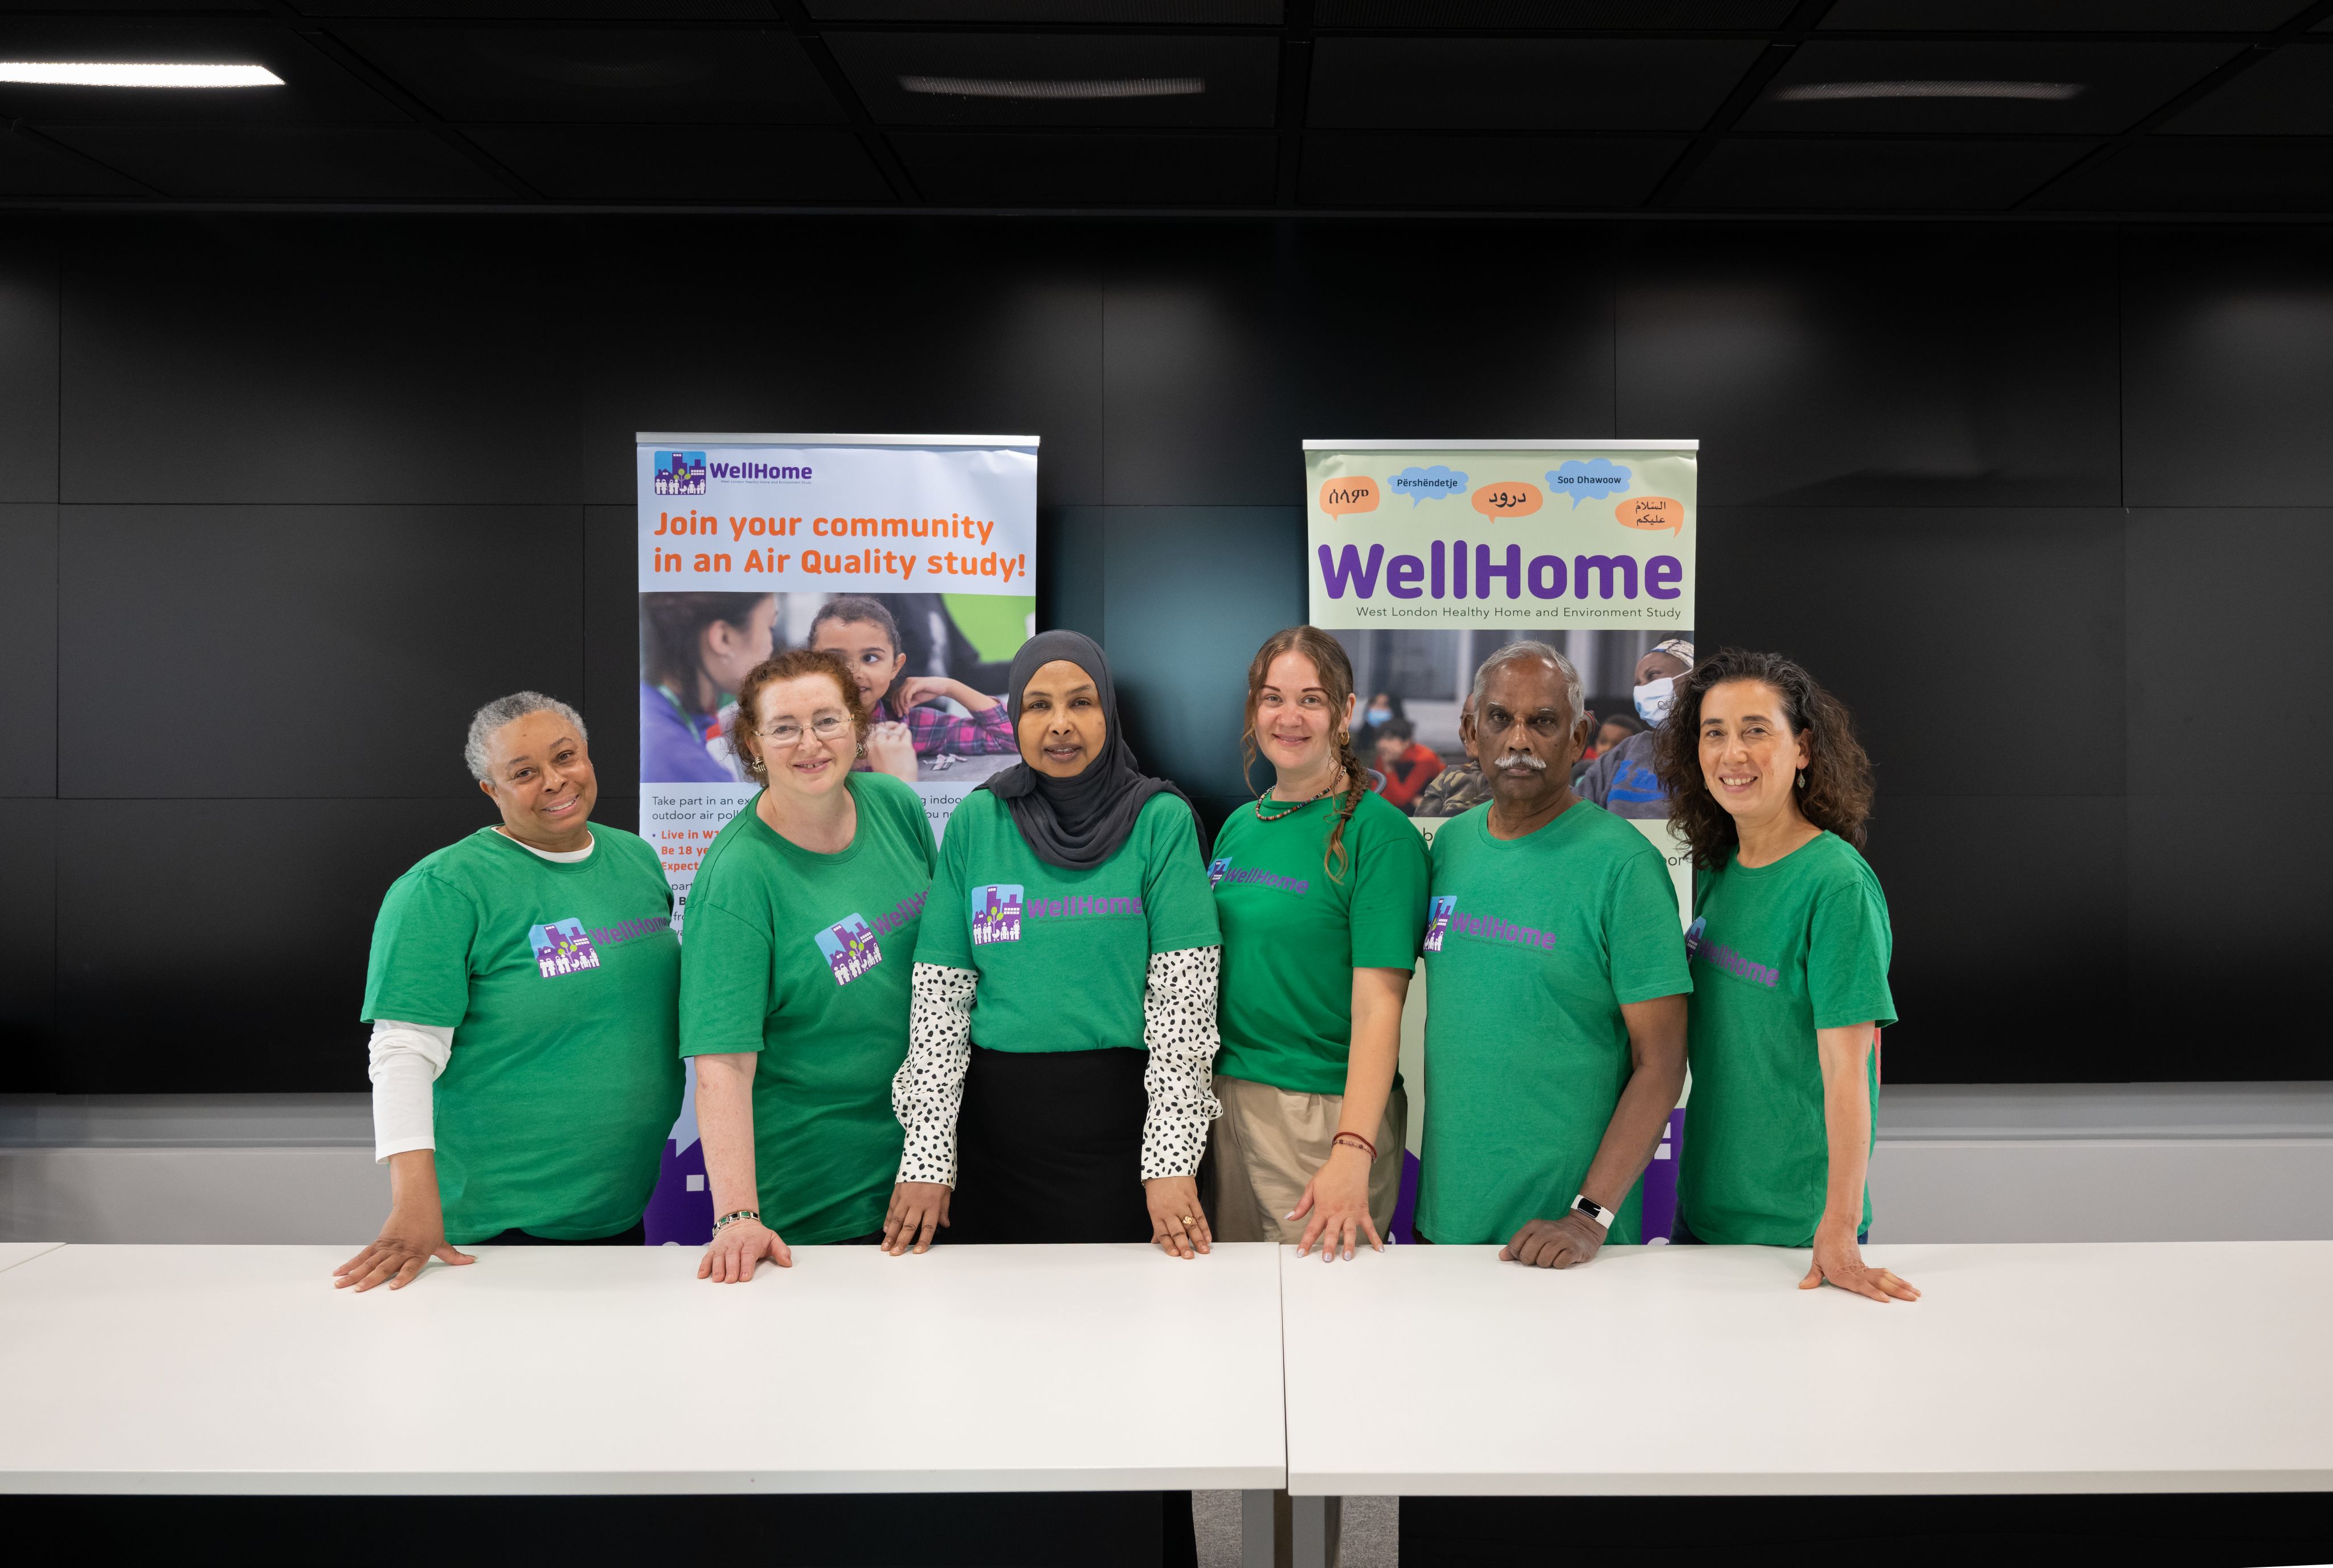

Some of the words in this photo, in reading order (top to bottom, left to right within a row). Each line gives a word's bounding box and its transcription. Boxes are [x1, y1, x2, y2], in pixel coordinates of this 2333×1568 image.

[710, 462, 812, 480] WellHome
[1397, 478, 1458, 489] Përshëndetje
[1329, 489, 1369, 504] ሰላም
[1489, 492, 1526, 507] درود
[654, 510, 717, 536] Join
[729, 515, 802, 542] your
[813, 513, 994, 546] community
[1636, 514, 1665, 527] عليكم
[654, 547, 682, 572] in
[693, 553, 732, 572] an
[744, 547, 791, 573] Air
[801, 548, 916, 580] Quality
[927, 551, 1025, 583] study!
[1318, 540, 1683, 600] WellHome
[1356, 607, 1387, 616] West
[1392, 607, 1438, 617] London
[1443, 607, 1490, 620] Healthy
[1495, 607, 1531, 617] Home
[1536, 607, 1558, 617] and
[1563, 607, 1642, 617] Environment
[1647, 607, 1681, 620] Study
[652, 796, 676, 805] Take
[680, 797, 703, 808] part
[706, 796, 716, 805] in
[930, 795, 963, 804] indoo
[652, 810, 696, 820] outdoor
[699, 810, 714, 820] air
[661, 830, 684, 839] Live
[687, 830, 698, 839] in
[661, 846, 675, 855] Be
[678, 846, 692, 855] 18
[661, 861, 699, 873] Expect
[1224, 866, 1309, 894] WellHome
[1026, 895, 1142, 918] WellHome
[1452, 911, 1556, 950] WellHome
[1699, 938, 1780, 987] WellHome
